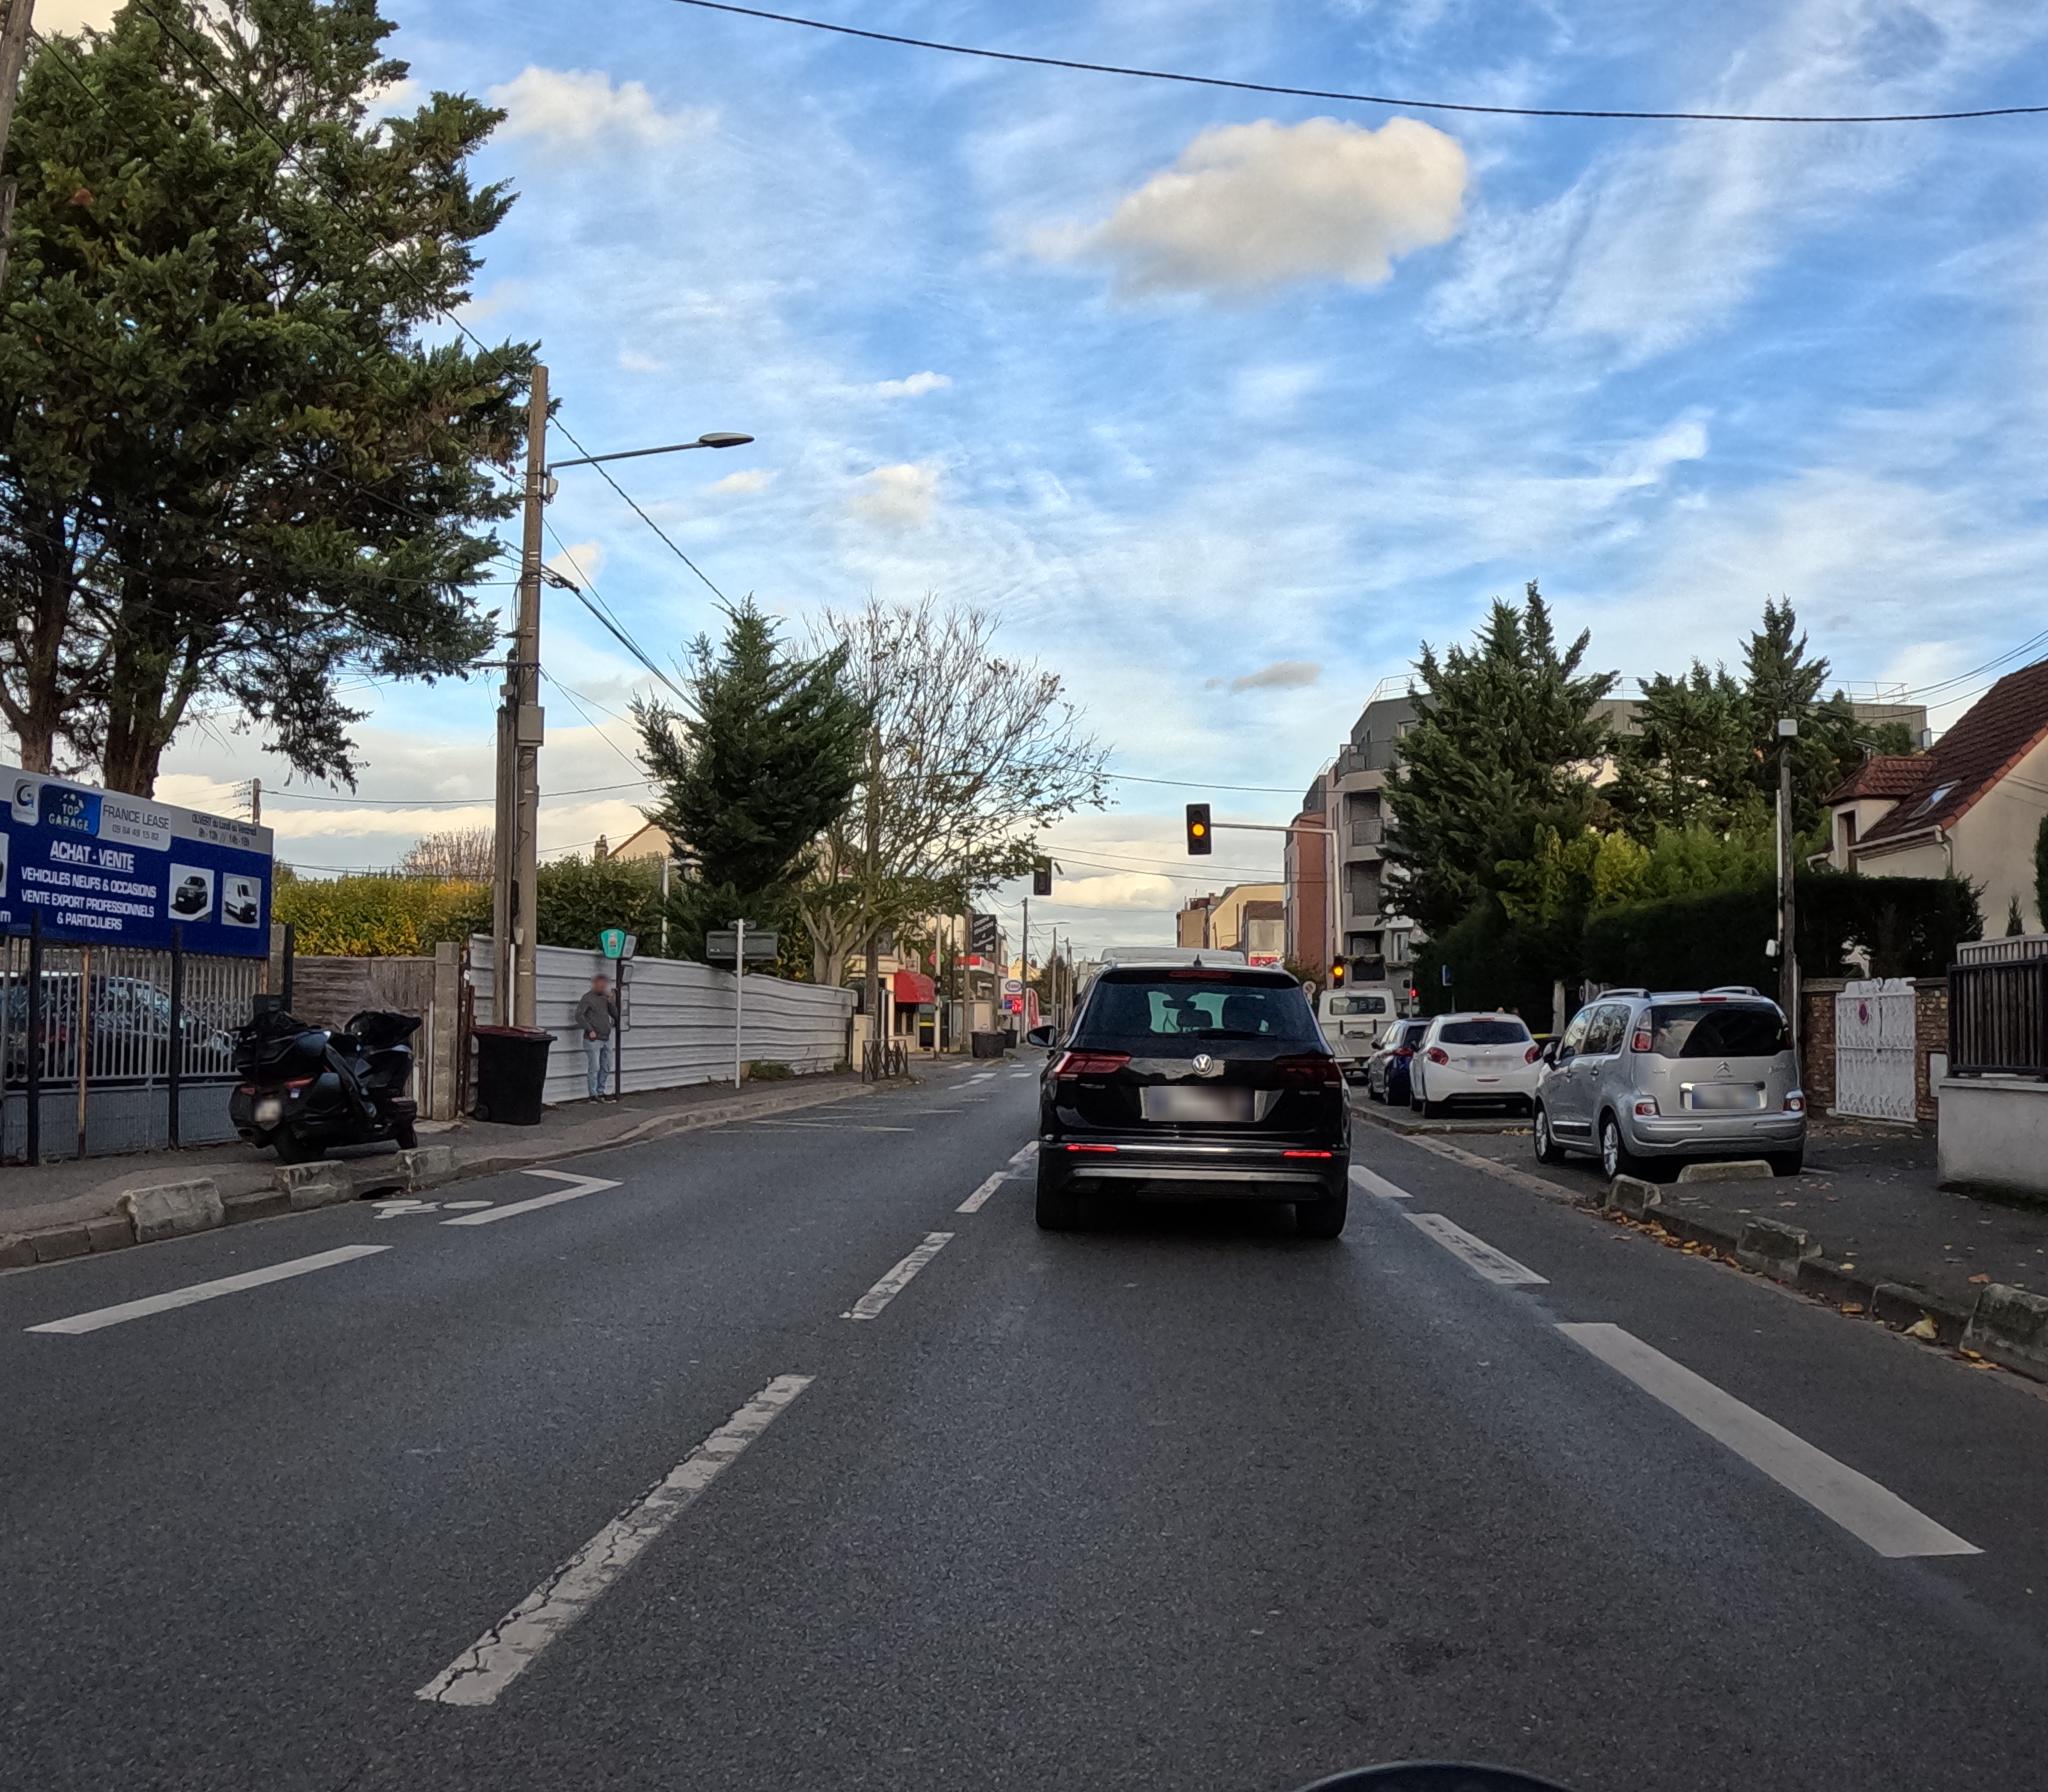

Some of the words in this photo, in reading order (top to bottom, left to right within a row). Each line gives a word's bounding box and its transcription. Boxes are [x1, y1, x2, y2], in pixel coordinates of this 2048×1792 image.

[49, 812, 89, 831] GARAGE
[62, 803, 80, 815] TOP
[102, 805, 140, 824] FRANCE
[142, 813, 170, 830] LEASE
[50, 840, 91, 863] ACHAT
[99, 848, 135, 871] VENTE
[21, 866, 71, 886] VEHICULES
[72, 873, 101, 890] NEUFS
[103, 879, 109, 890] &
[110, 881, 157, 898] OCCASIONS
[21, 889, 51, 905] VENTE
[51, 893, 85, 909] EXPORT
[86, 898, 155, 918] PROFESSIONNELS
[57, 913, 63, 925] &
[65, 912, 123, 931] PARTICULIERS
